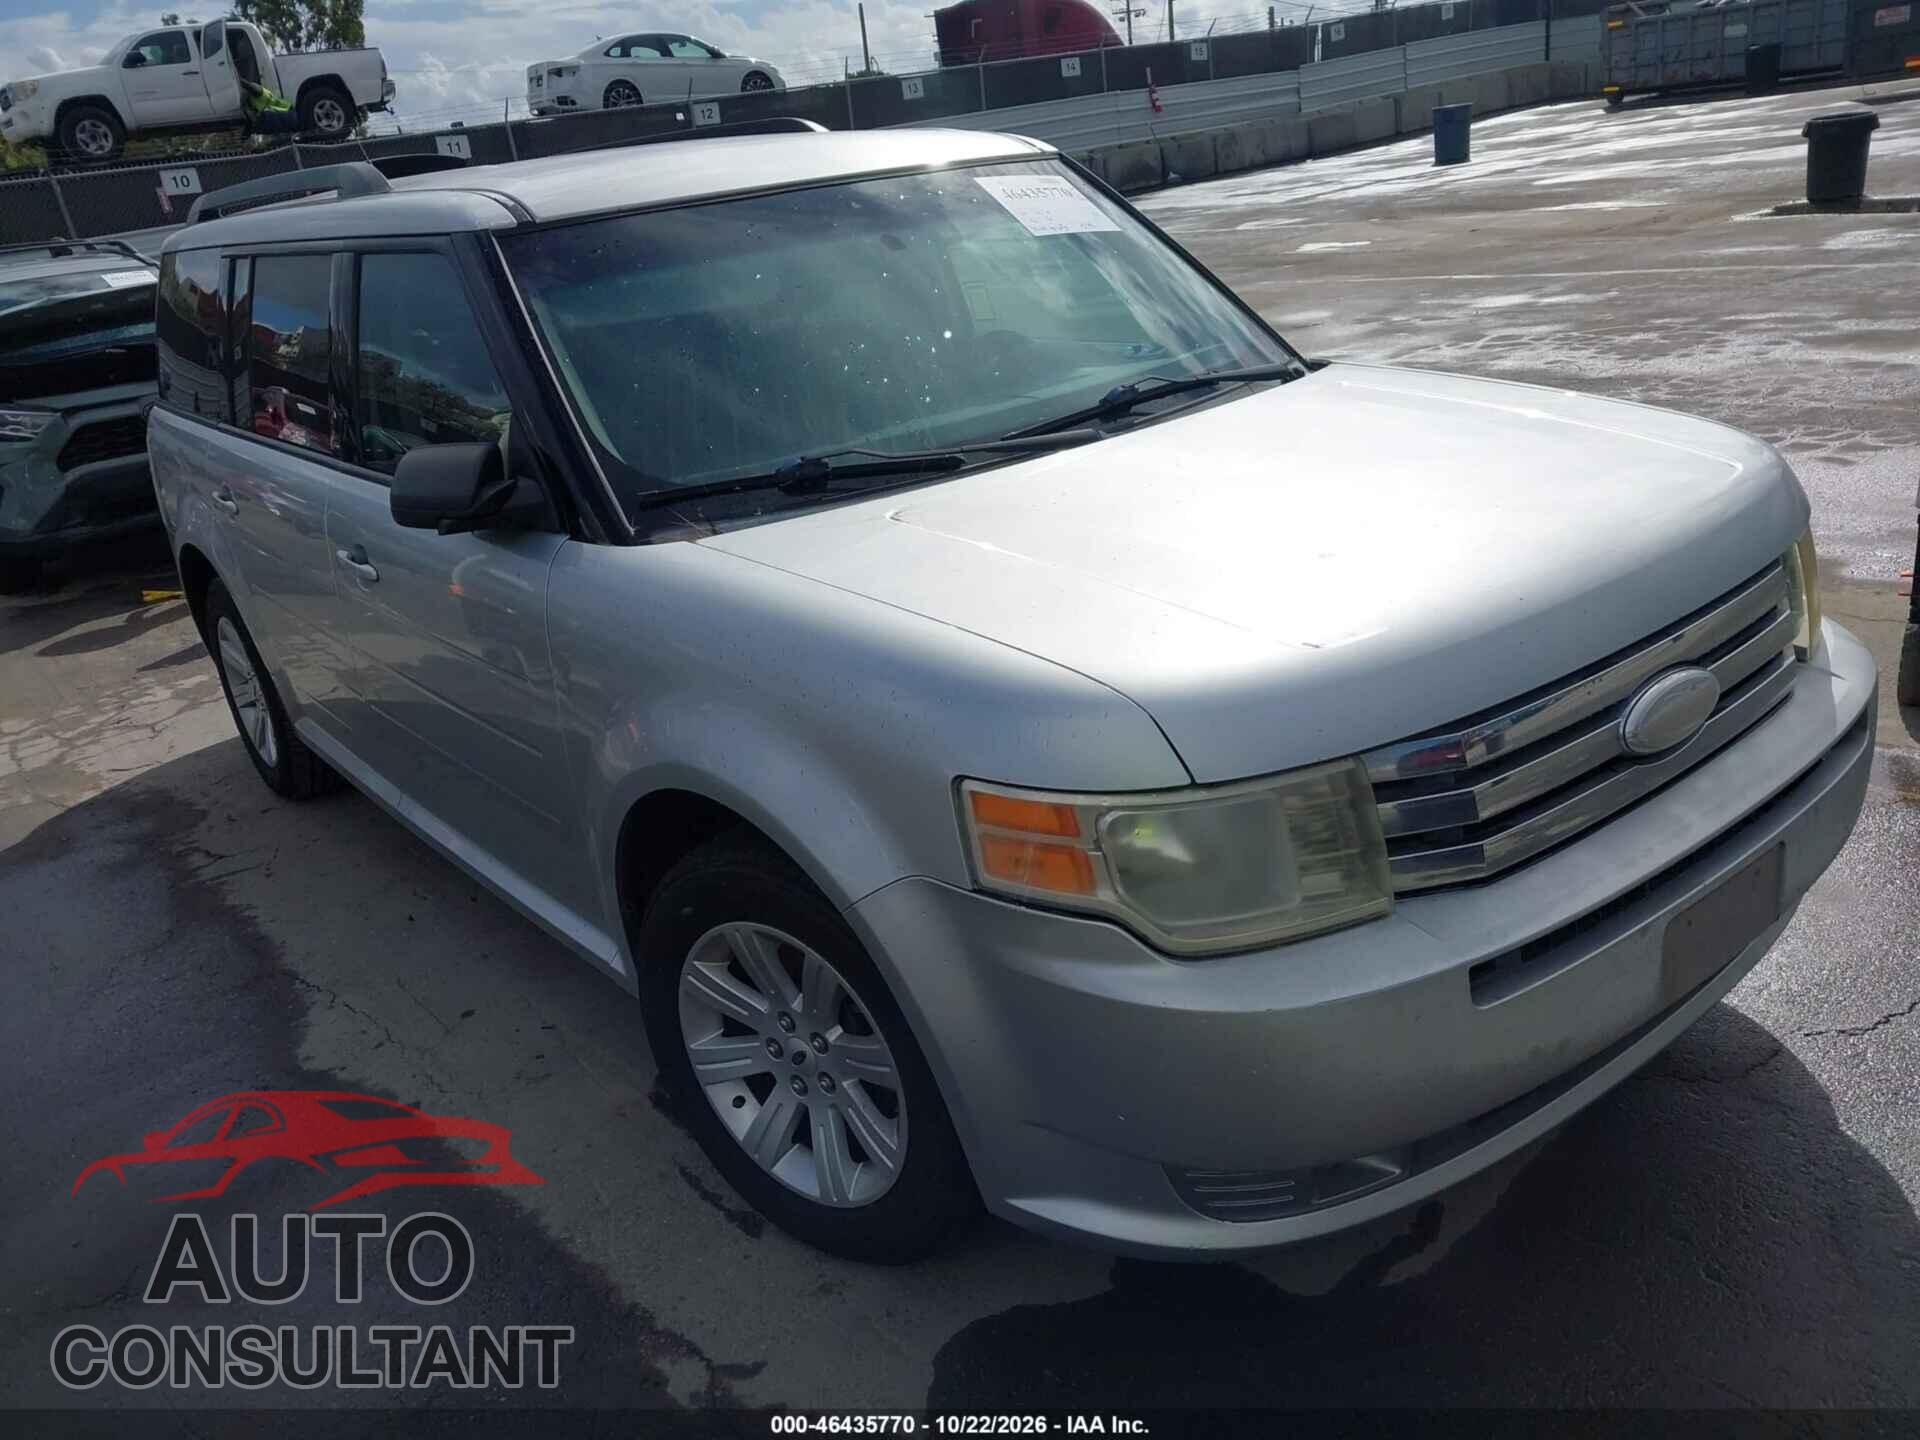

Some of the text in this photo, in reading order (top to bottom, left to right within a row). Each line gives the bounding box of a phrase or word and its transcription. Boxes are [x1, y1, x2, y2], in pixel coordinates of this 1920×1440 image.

[1066, 61, 1077, 72] 14
[908, 82, 919, 95] 13
[701, 108, 713, 120] 12
[446, 141, 462, 153] 11
[171, 175, 191, 189] 10
